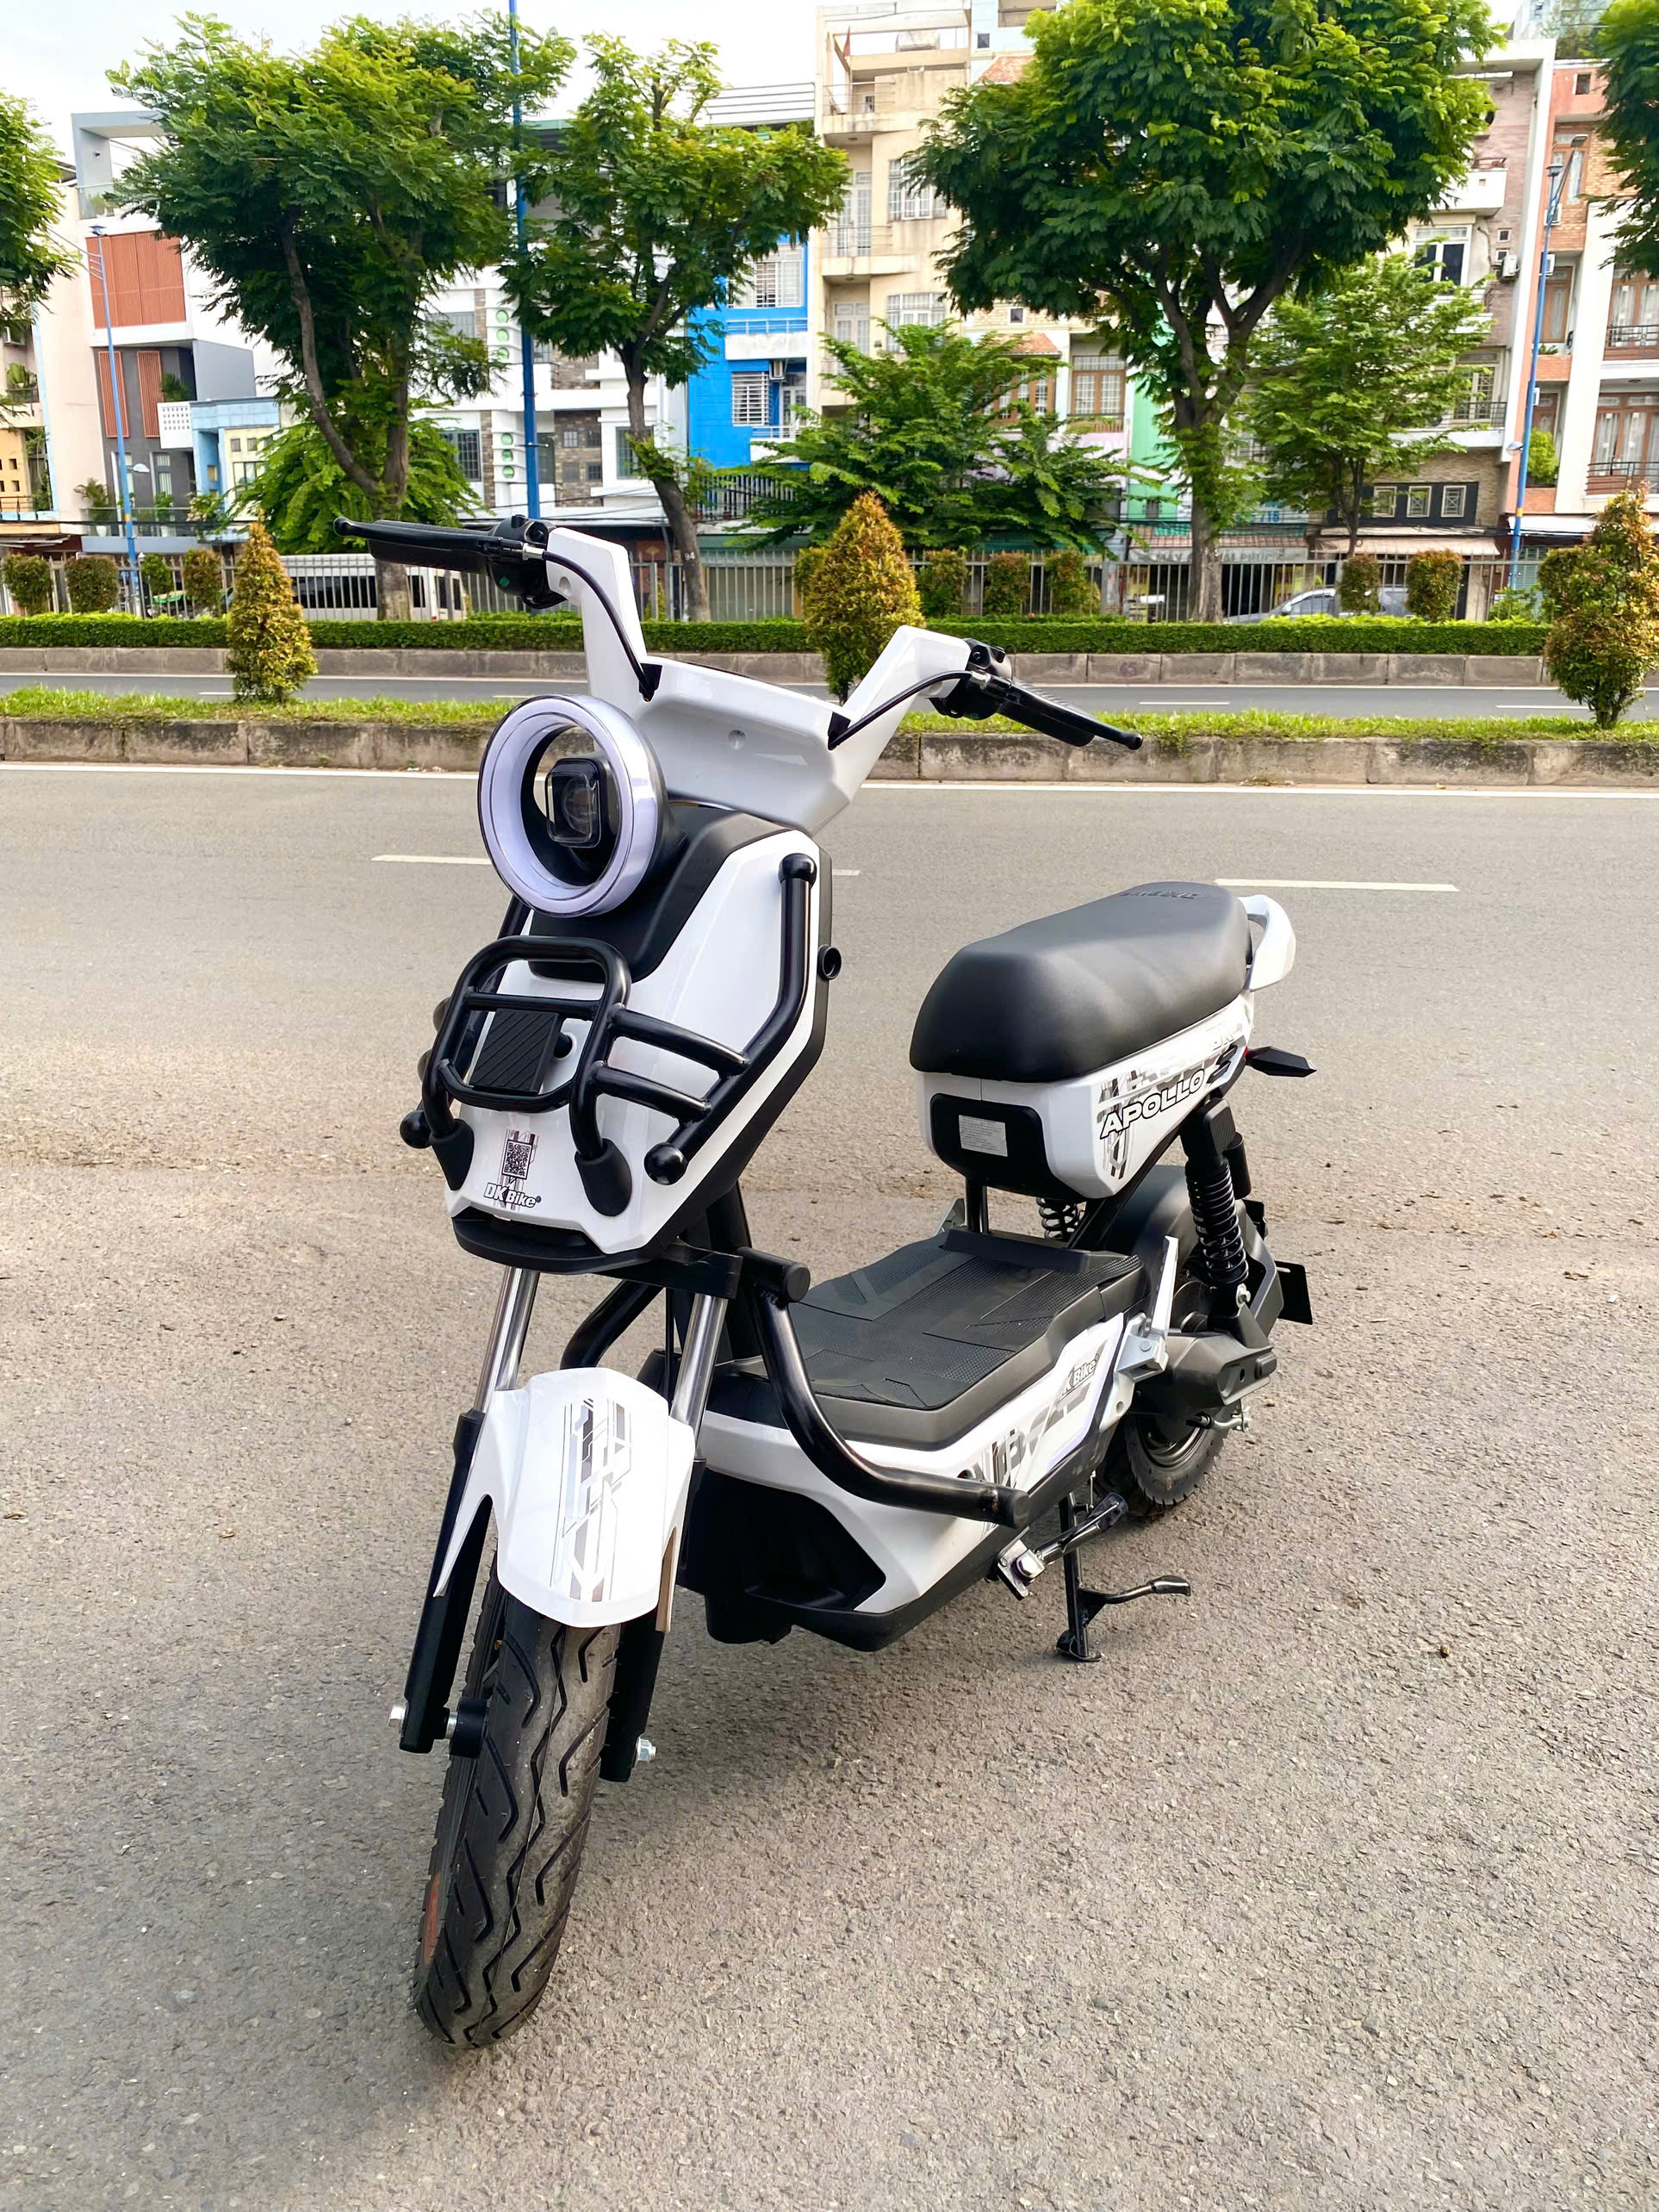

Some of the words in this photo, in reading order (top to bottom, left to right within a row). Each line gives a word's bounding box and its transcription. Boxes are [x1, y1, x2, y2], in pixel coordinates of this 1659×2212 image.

[1100, 1068, 1205, 1140] APOLLO
[483, 1183, 509, 1202] DK
[505, 1190, 537, 1208] Bike
